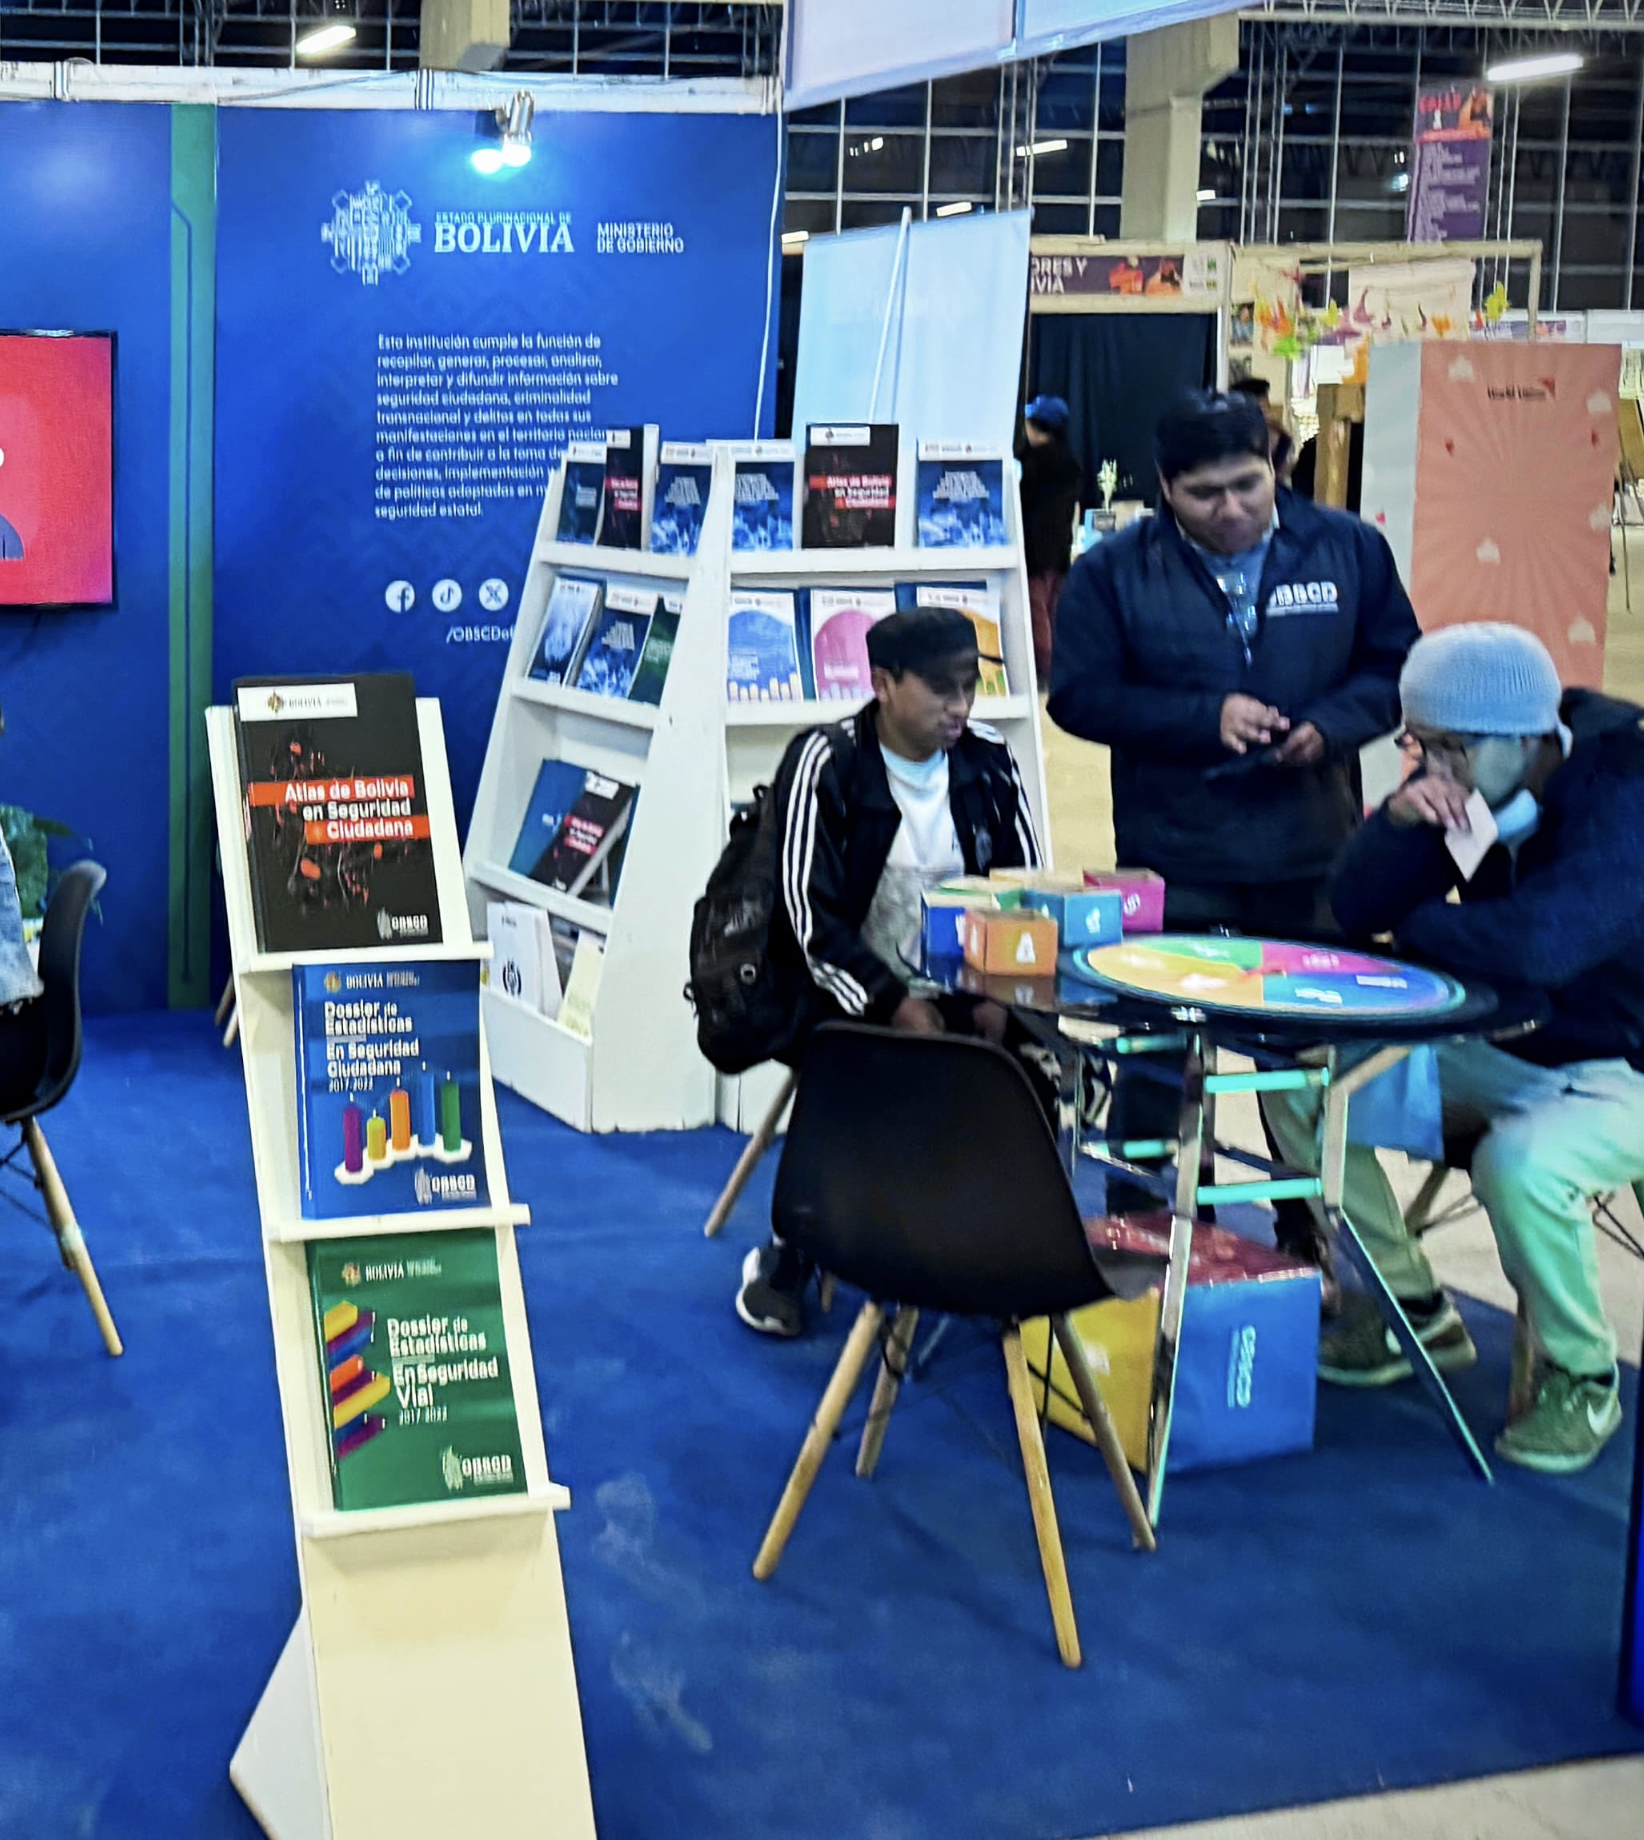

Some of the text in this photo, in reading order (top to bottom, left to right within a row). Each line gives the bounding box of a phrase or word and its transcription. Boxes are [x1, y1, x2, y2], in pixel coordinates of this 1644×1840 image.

[436, 212, 475, 224] ESTADO
[477, 212, 555, 224] PLURINACIONAL
[435, 223, 574, 253] BOLIVIA
[597, 222, 673, 238] MINISTERIO
[597, 238, 684, 253] DE GOBIERNO
[378, 332, 601, 351] Esta institución cumple la función de
[377, 353, 602, 371] recopilar, generar, procesar, analizar,
[377, 371, 618, 389] interpretar y difundir información sobre
[377, 391, 439, 408] seguridad
[514, 389, 591, 404] criminalidad
[376, 408, 592, 427] transnacional y delitos en todas sus
[376, 428, 477, 444] manifestaciones
[480, 430, 495, 442] en
[498, 427, 510, 442] el
[513, 427, 565, 442] territorio
[376, 451, 384, 462] a
[388, 447, 403, 461] fin
[406, 447, 422, 461] de
[487, 448, 496, 461] a
[499, 446, 511, 460] la
[513, 447, 546, 460] toma
[375, 485, 391, 499] de
[517, 486, 532, 498] en
[375, 503, 437, 519] seguridad
[285, 778, 408, 802] Atlas de Bolivia
[303, 799, 410, 821] en Seguridad
[327, 820, 413, 839] Ciudadana
[346, 973, 384, 989] BOLIVIA
[324, 1000, 398, 1019] Dossier de
[327, 1037, 420, 1060] En Seguridad
[327, 1060, 401, 1079] Ciudadana
[365, 1263, 404, 1281] BOLIVIA
[387, 1314, 468, 1337] Dossier de
[393, 1356, 498, 1386] En Seguridad
[396, 1383, 433, 1409] Vial
